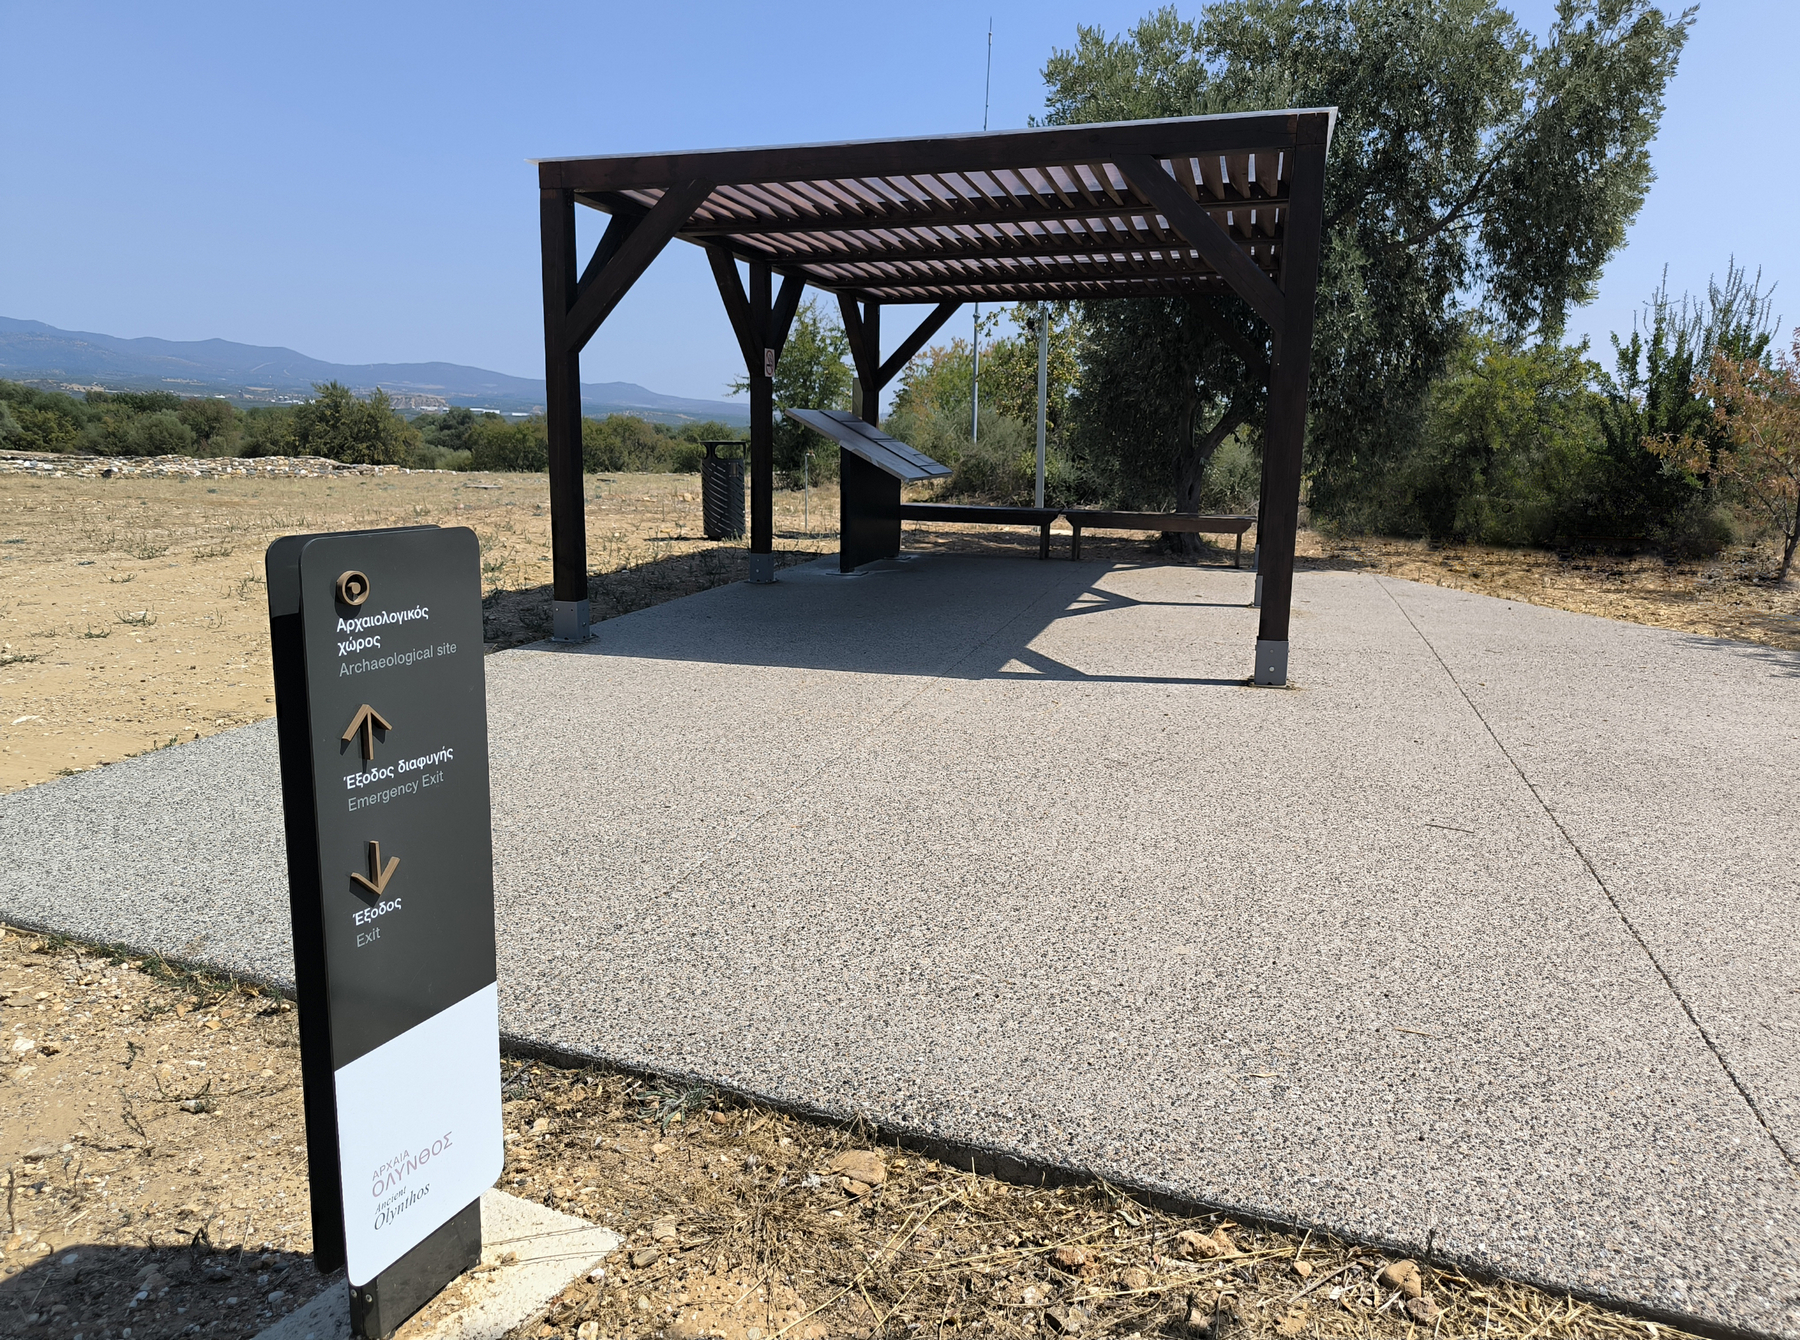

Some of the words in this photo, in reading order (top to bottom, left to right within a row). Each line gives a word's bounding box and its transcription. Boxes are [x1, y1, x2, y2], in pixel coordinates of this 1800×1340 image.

[336, 604, 429, 634] Αρχαιολογικός
[337, 635, 381, 656] χώρος
[339, 645, 434, 677] Archaeological
[436, 641, 457, 656] site
[343, 765, 394, 790] Έξοδος
[398, 746, 454, 773] διαφυγής
[348, 778, 419, 812] Emergency
[422, 770, 444, 788] Exit
[352, 898, 402, 926] Έξοδος
[356, 926, 381, 948] Exit
[372, 1131, 453, 1198] ΟΛΥΝΘΟΣ
[372, 1149, 410, 1181] ΑΡΧΑΙΑ
[374, 1183, 430, 1230] Olynthos
[375, 1185, 407, 1215] Ancient
